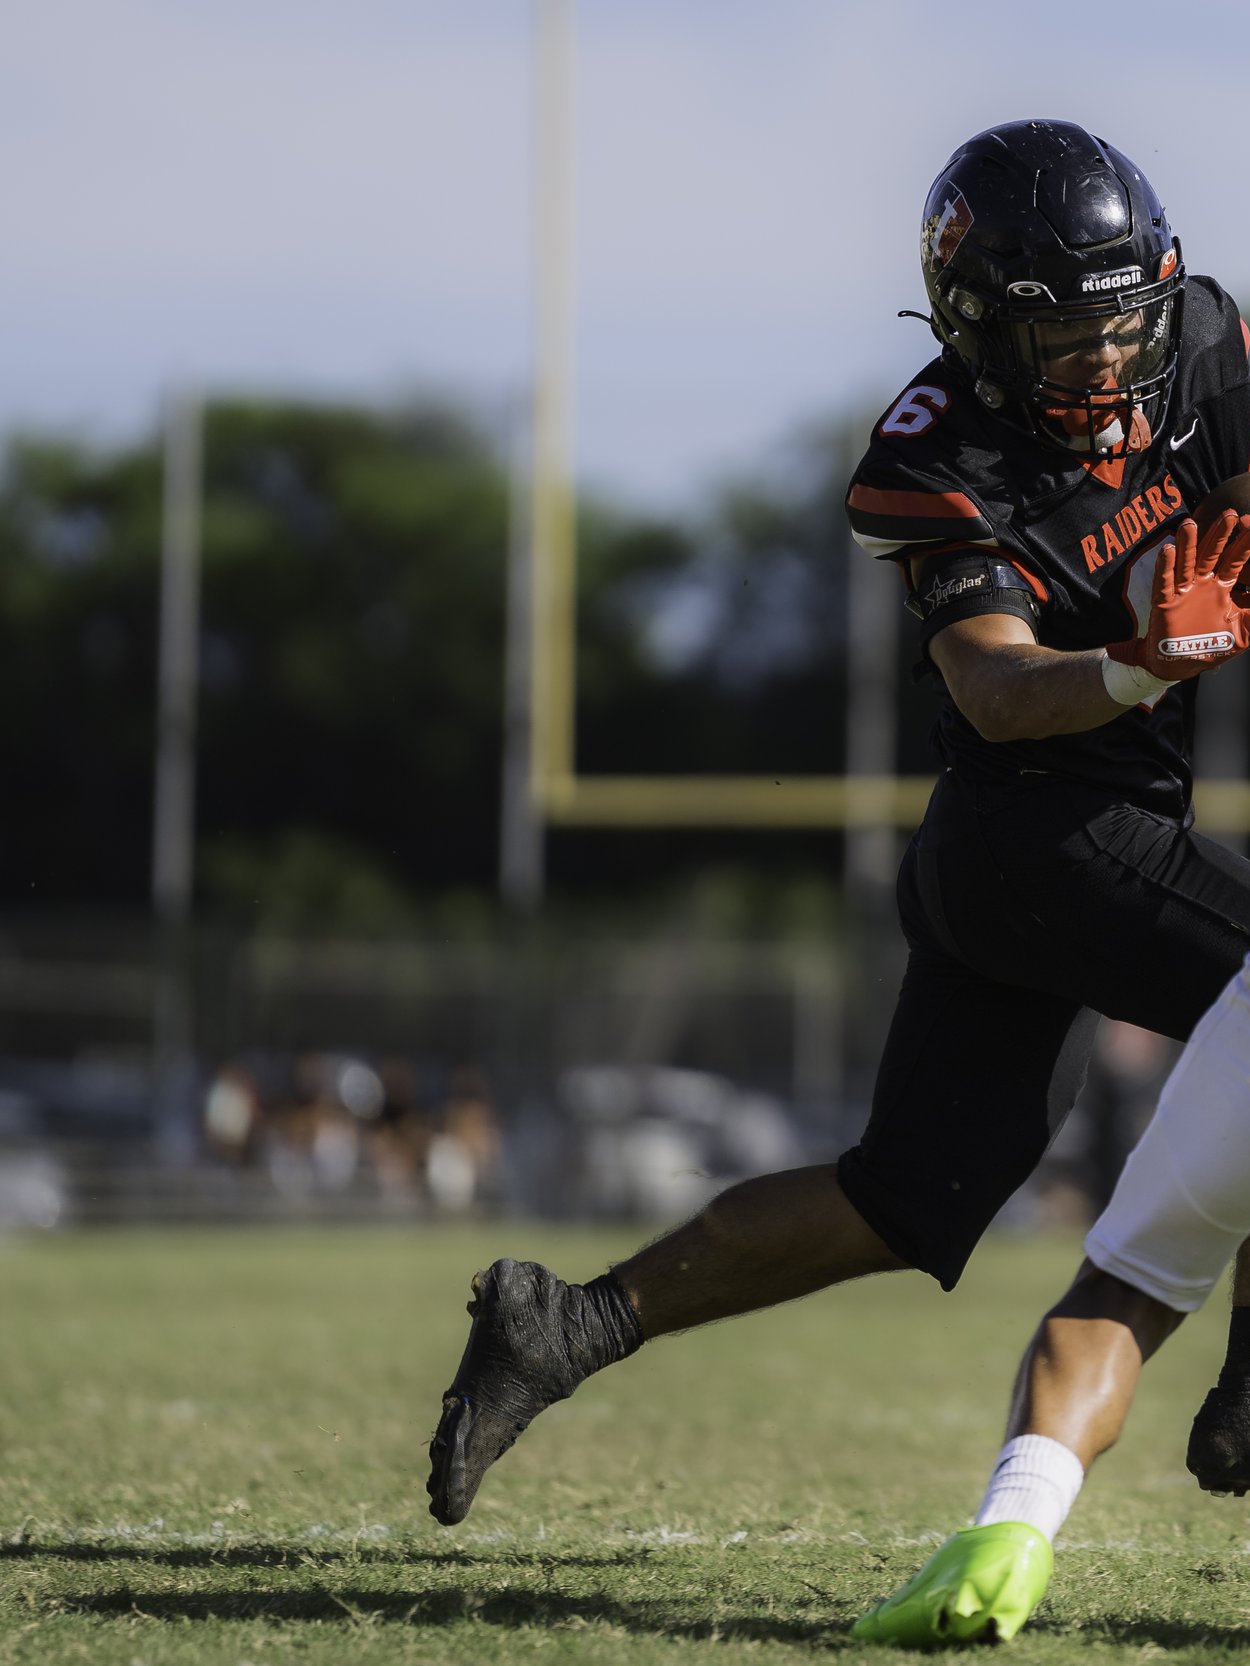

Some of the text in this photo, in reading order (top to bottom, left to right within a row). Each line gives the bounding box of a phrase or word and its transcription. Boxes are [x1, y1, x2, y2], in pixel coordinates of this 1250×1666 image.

[1082, 271, 1141, 292] Riddell
[879, 385, 951, 437] 6
[1080, 473, 1182, 574] RAIDERS
[934, 577, 982, 601] Douglas
[1166, 635, 1229, 652] BATTLE
